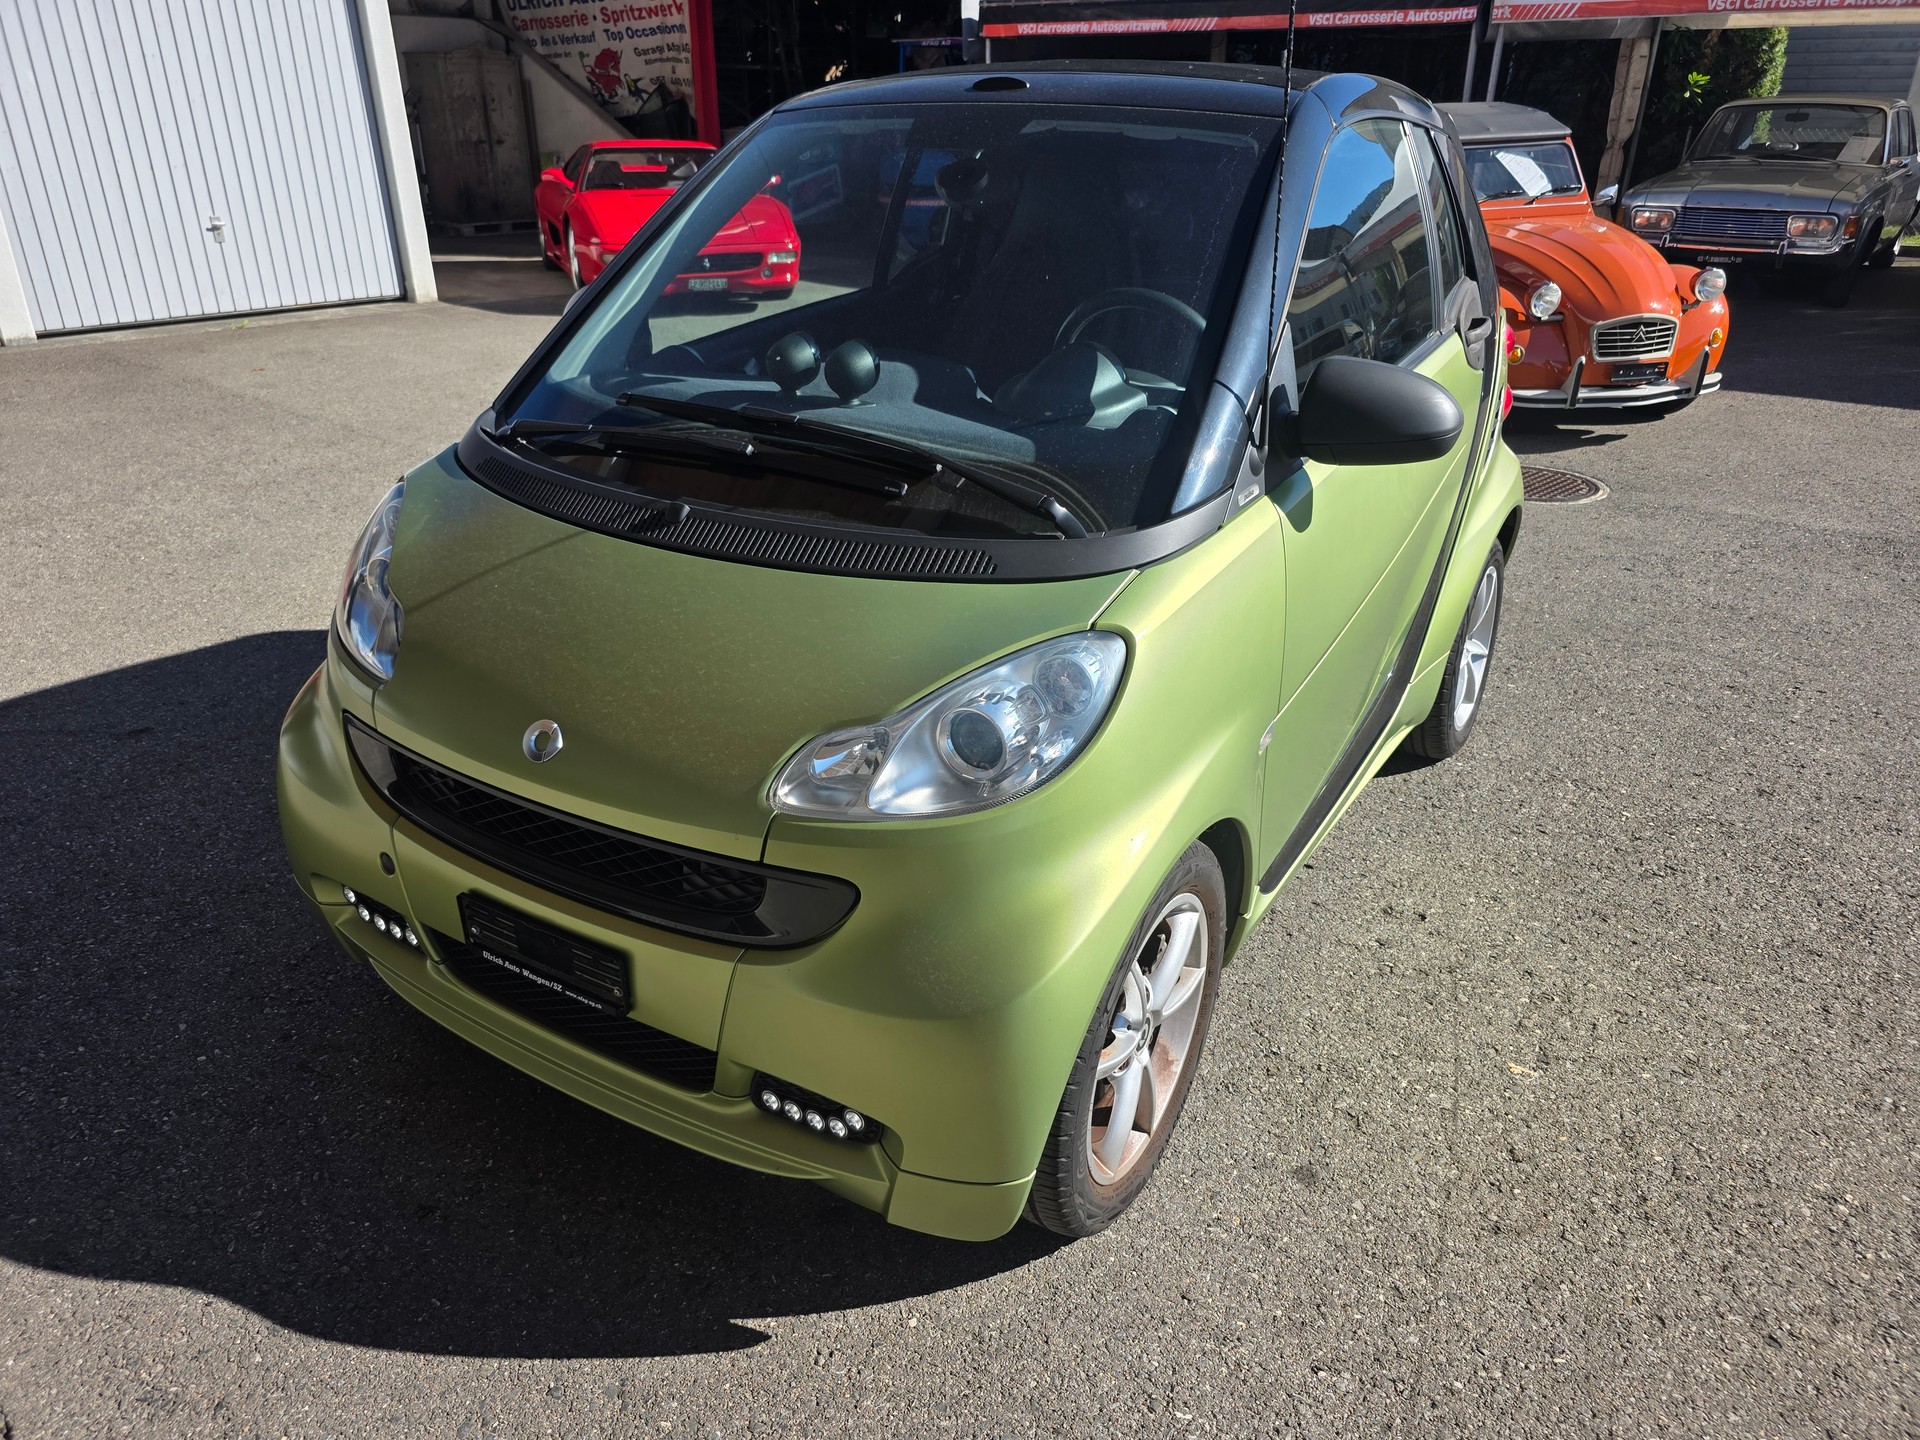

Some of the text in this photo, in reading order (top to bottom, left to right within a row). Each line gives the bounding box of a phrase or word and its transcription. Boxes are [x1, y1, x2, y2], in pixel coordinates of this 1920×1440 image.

[511, 0, 684, 32] Carrosserie Spritzwerk
[1309, 13, 1333, 25] VSCI
[1335, 11, 1404, 24] Carrosserie
[1017, 20, 1168, 34] VSCI Carrosserie Autospritzwerk
[557, 31, 596, 45] Verkauf
[603, 28, 624, 43] Top
[482, 950, 504, 966] Ulrich
[504, 961, 520, 973] Auto
[522, 968, 563, 992] Wangen/SZ
